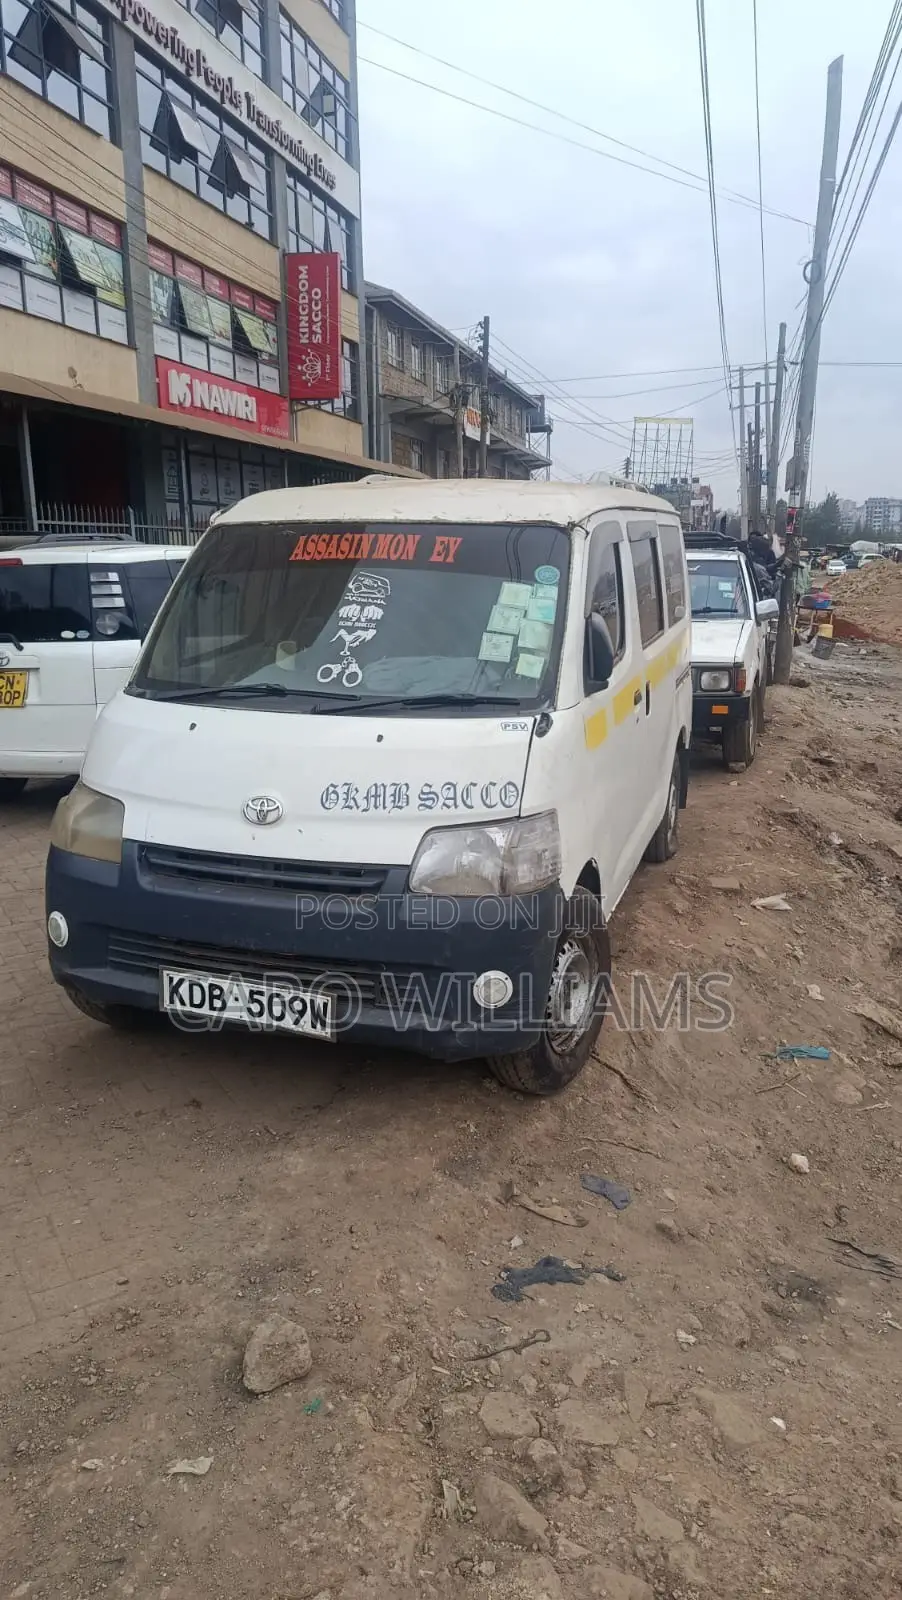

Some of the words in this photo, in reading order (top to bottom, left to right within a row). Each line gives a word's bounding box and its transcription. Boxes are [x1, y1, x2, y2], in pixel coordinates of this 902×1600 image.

[110, 0, 195, 77] powering
[244, 91, 313, 177] Transforming
[312, 153, 337, 192] Lives
[298, 264, 309, 344] KINGDOM
[311, 287, 322, 344] SACCO
[289, 532, 375, 561] ASSASIN
[320, 782, 411, 813] GKMB
[417, 781, 520, 811] SACCO
[168, 975, 228, 1012] KDB
[246, 990, 329, 1030] 509W
